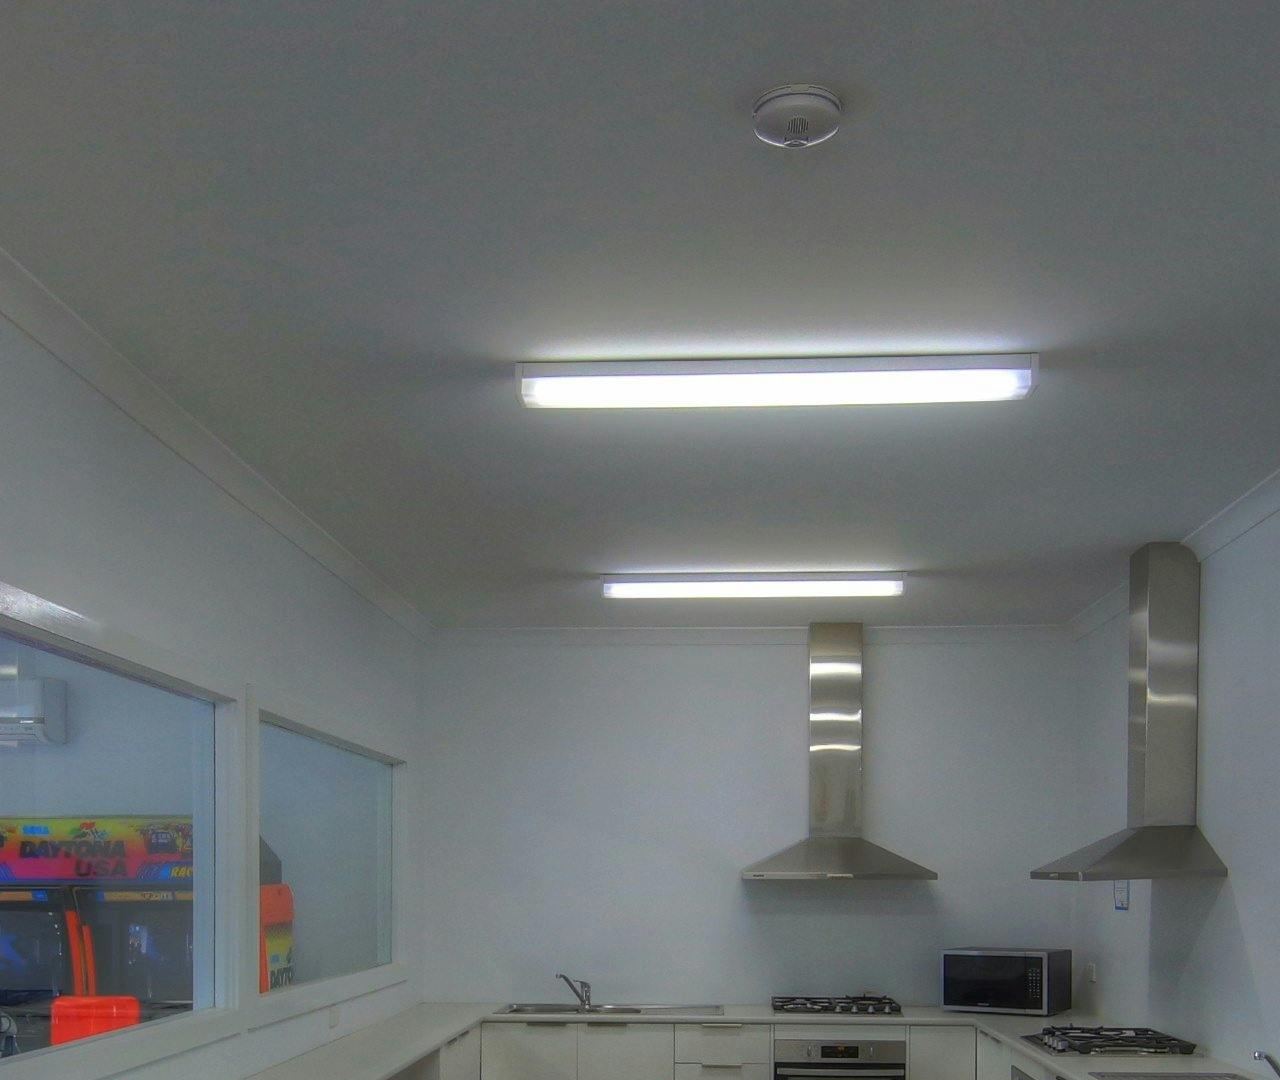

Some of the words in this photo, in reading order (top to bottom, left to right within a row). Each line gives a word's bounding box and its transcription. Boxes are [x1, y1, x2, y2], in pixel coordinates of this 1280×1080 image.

[20, 839, 126, 859] DAYTONA
[75, 859, 126, 877] USA
[172, 867, 193, 878] RAC
